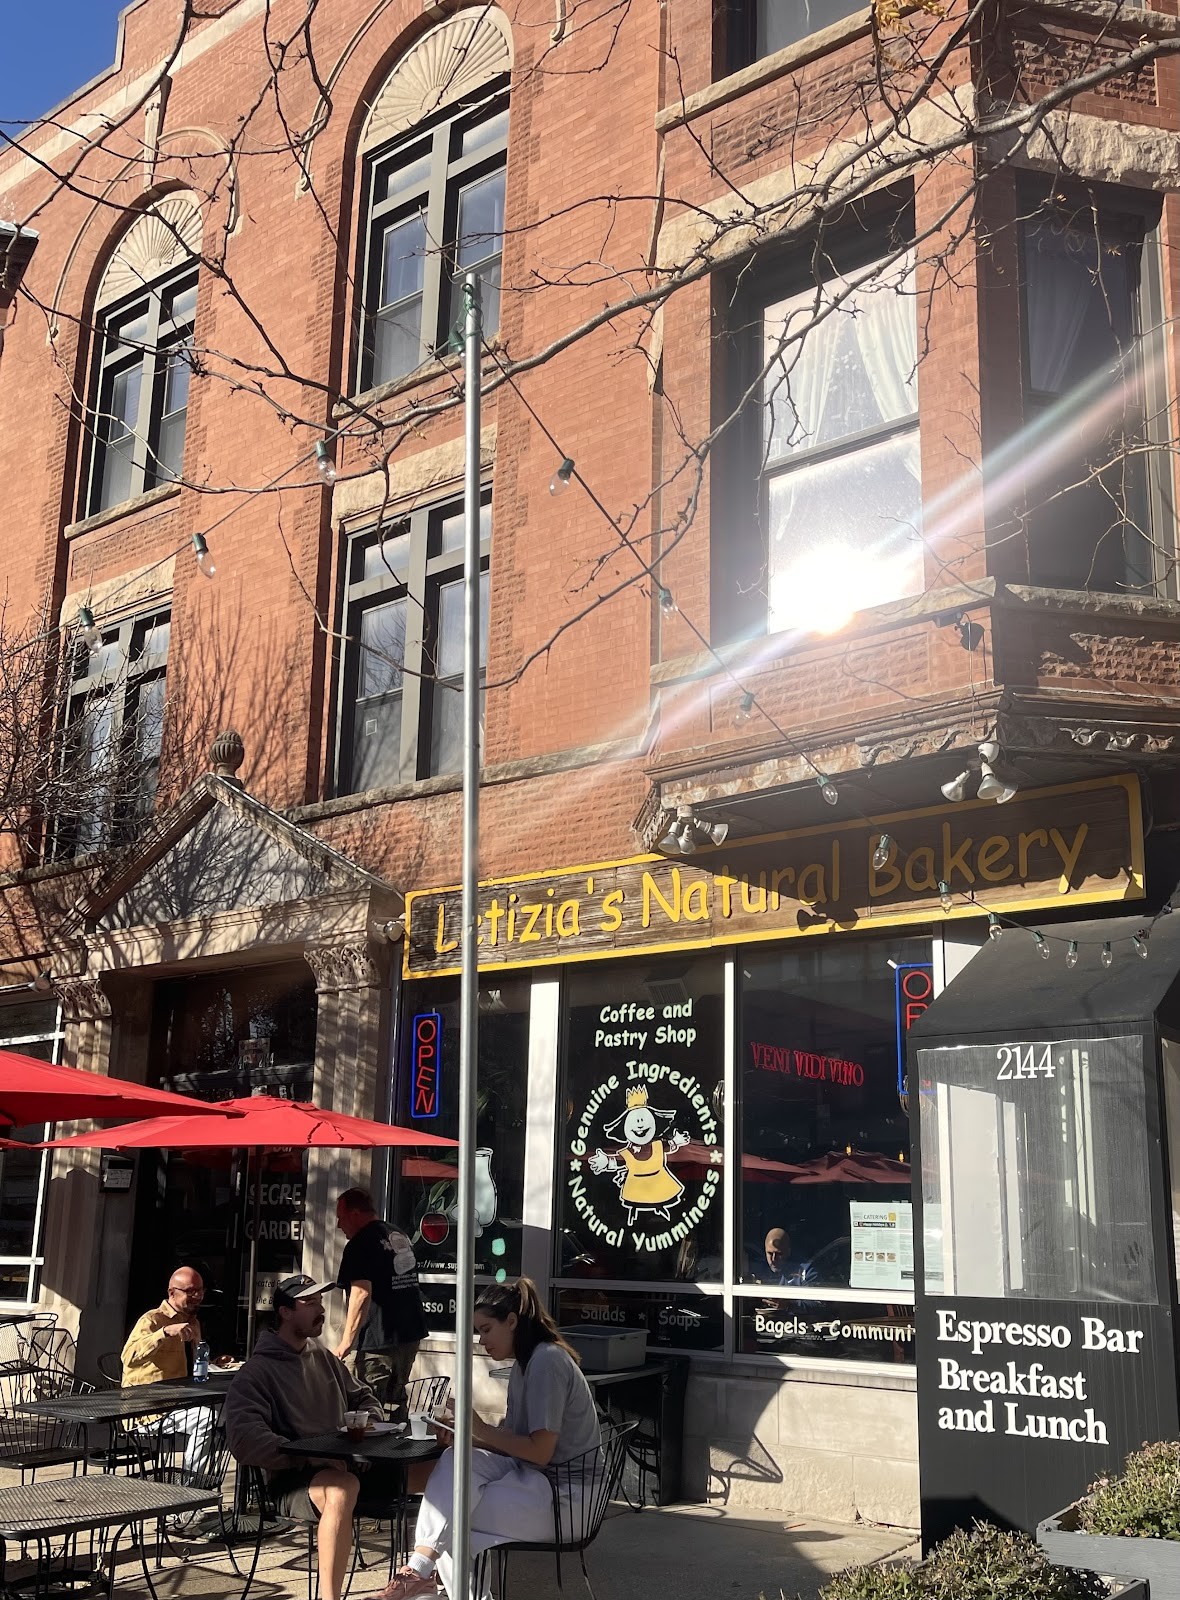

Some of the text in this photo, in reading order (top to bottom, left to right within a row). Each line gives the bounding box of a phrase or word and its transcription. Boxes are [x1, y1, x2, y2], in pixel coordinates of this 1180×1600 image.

[435, 821, 1089, 954] Ltizia's Natural Bakery
[600, 998, 693, 1023] Coffee and
[595, 1025, 697, 1050] Pastry Shop
[416, 1019, 437, 1114] OPEN
[751, 1042, 864, 1087] VENI VIDI VINO
[996, 1044, 1056, 1081] 2144
[570, 1060, 718, 1156] Genuine Ingredients
[248, 1183, 303, 1206] SECRE
[568, 1169, 720, 1252] Natural Yumminess
[863, 1213, 888, 1221] CATERING
[422, 1301, 444, 1314] sso
[580, 1305, 702, 1332] Salads Soups
[755, 1314, 915, 1342] Bagels Communi
[936, 1309, 1144, 1355] Espresso Bar
[938, 1357, 1088, 1401] Breakfast
[938, 1400, 1110, 1445] and Lunch
